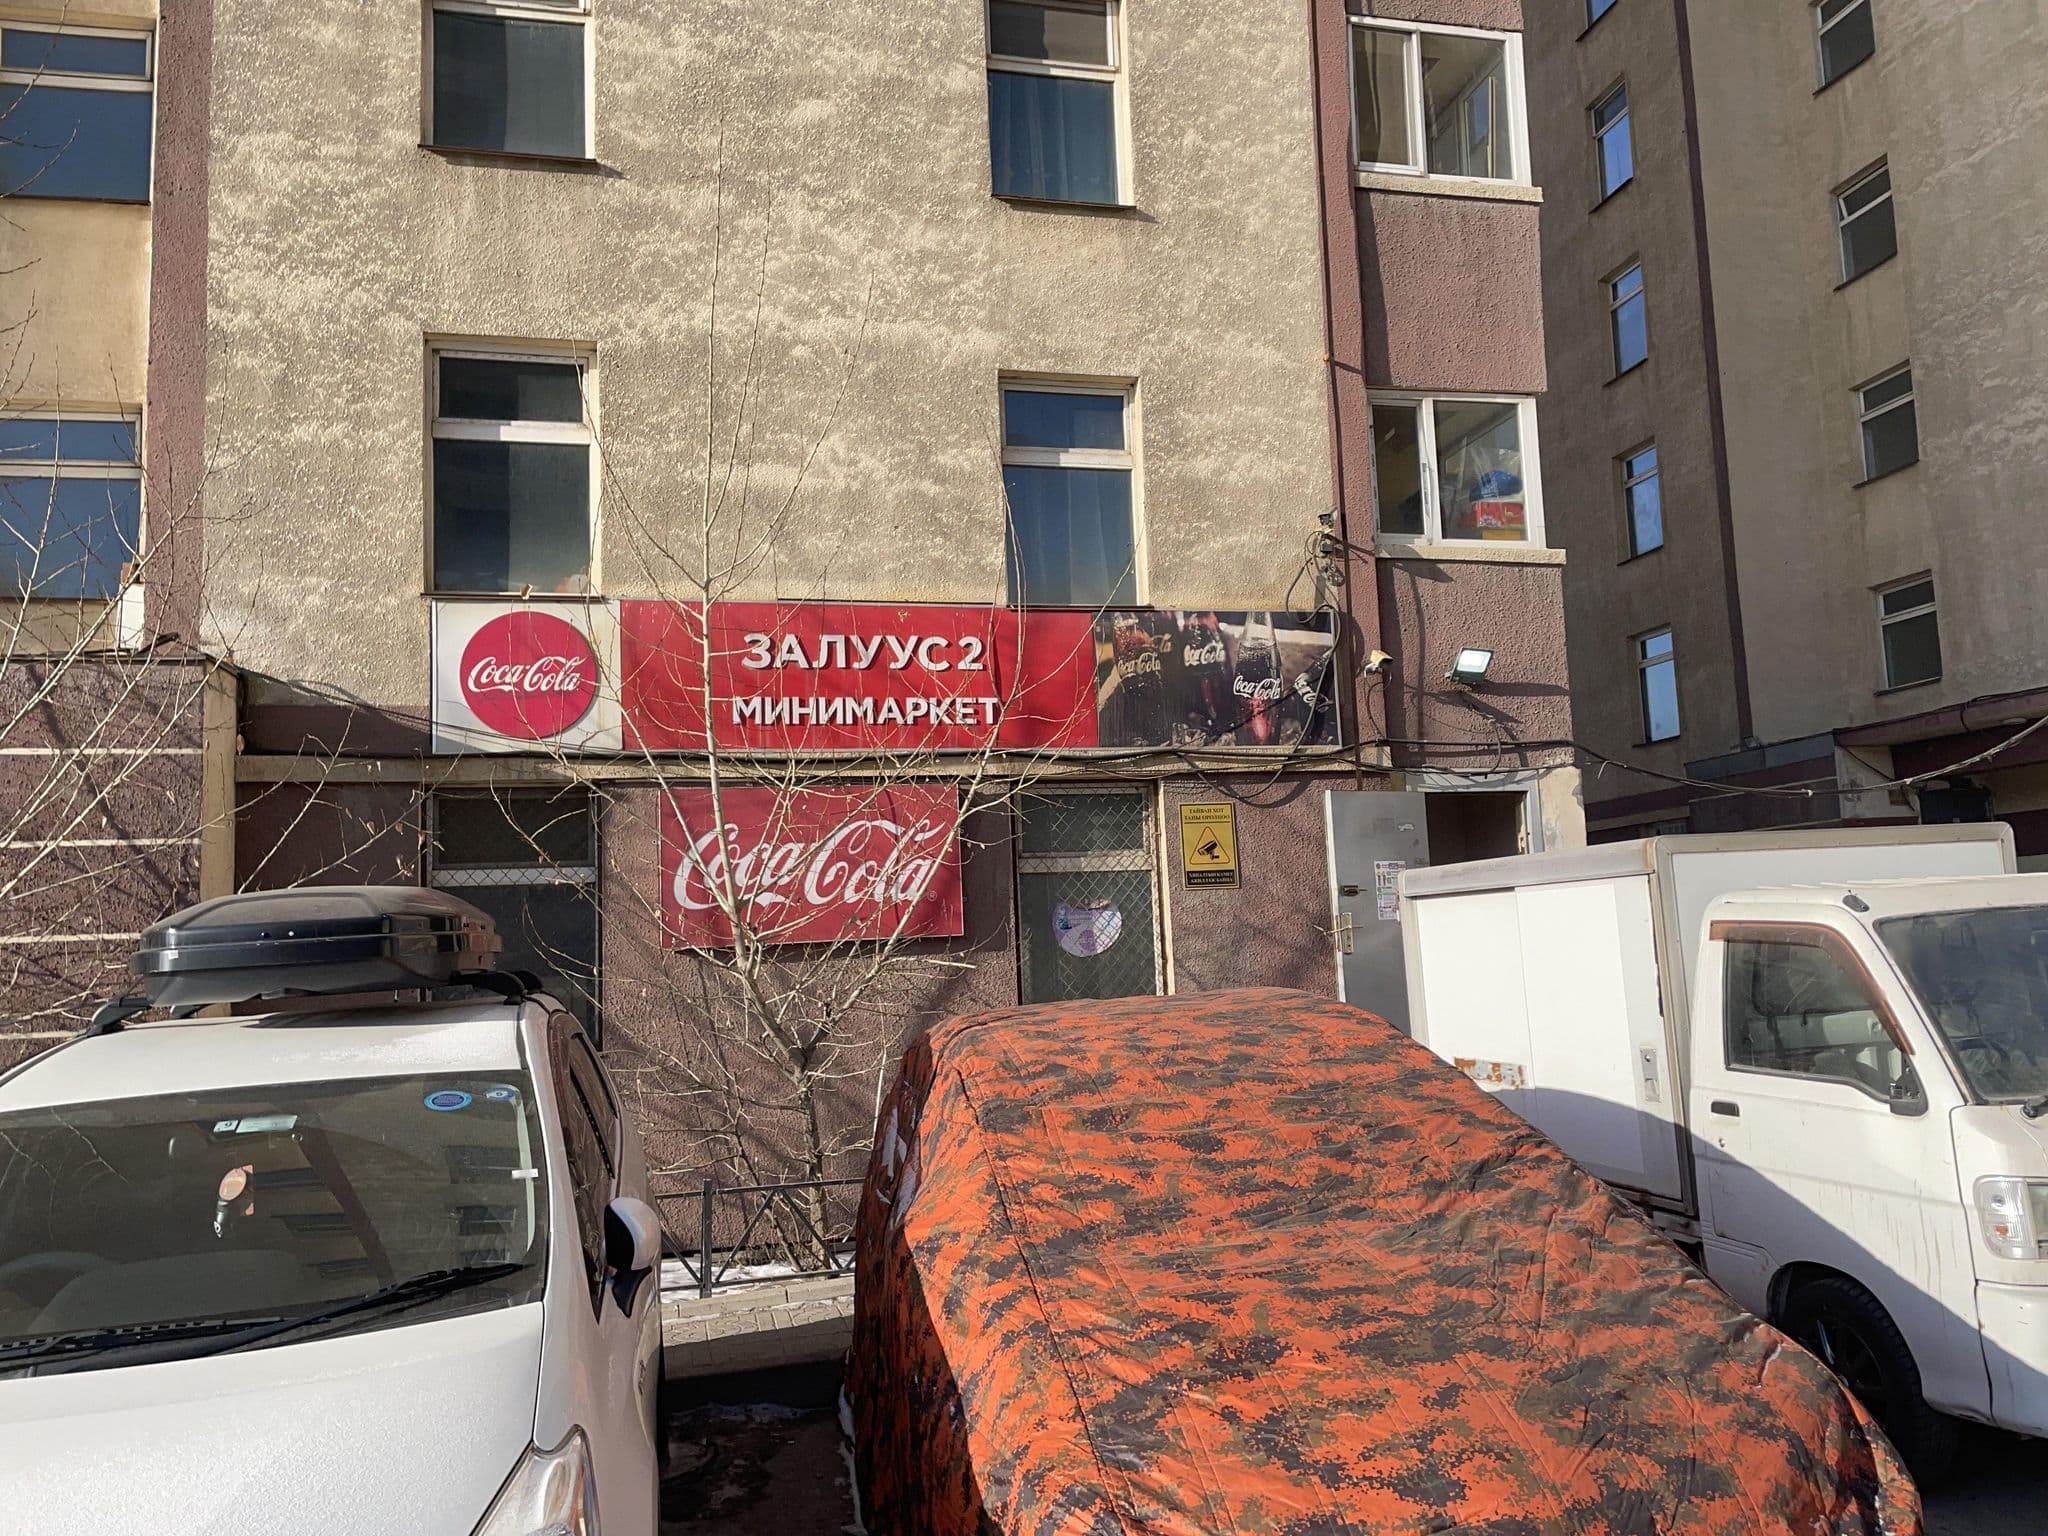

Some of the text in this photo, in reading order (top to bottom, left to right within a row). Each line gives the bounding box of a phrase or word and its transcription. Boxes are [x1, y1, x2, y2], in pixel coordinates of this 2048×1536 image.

[741, 632, 987, 672] ЗАЛУУС 2
[467, 656, 590, 693] Coca-Cola
[732, 696, 1000, 726] МИНИМАРКЕТ
